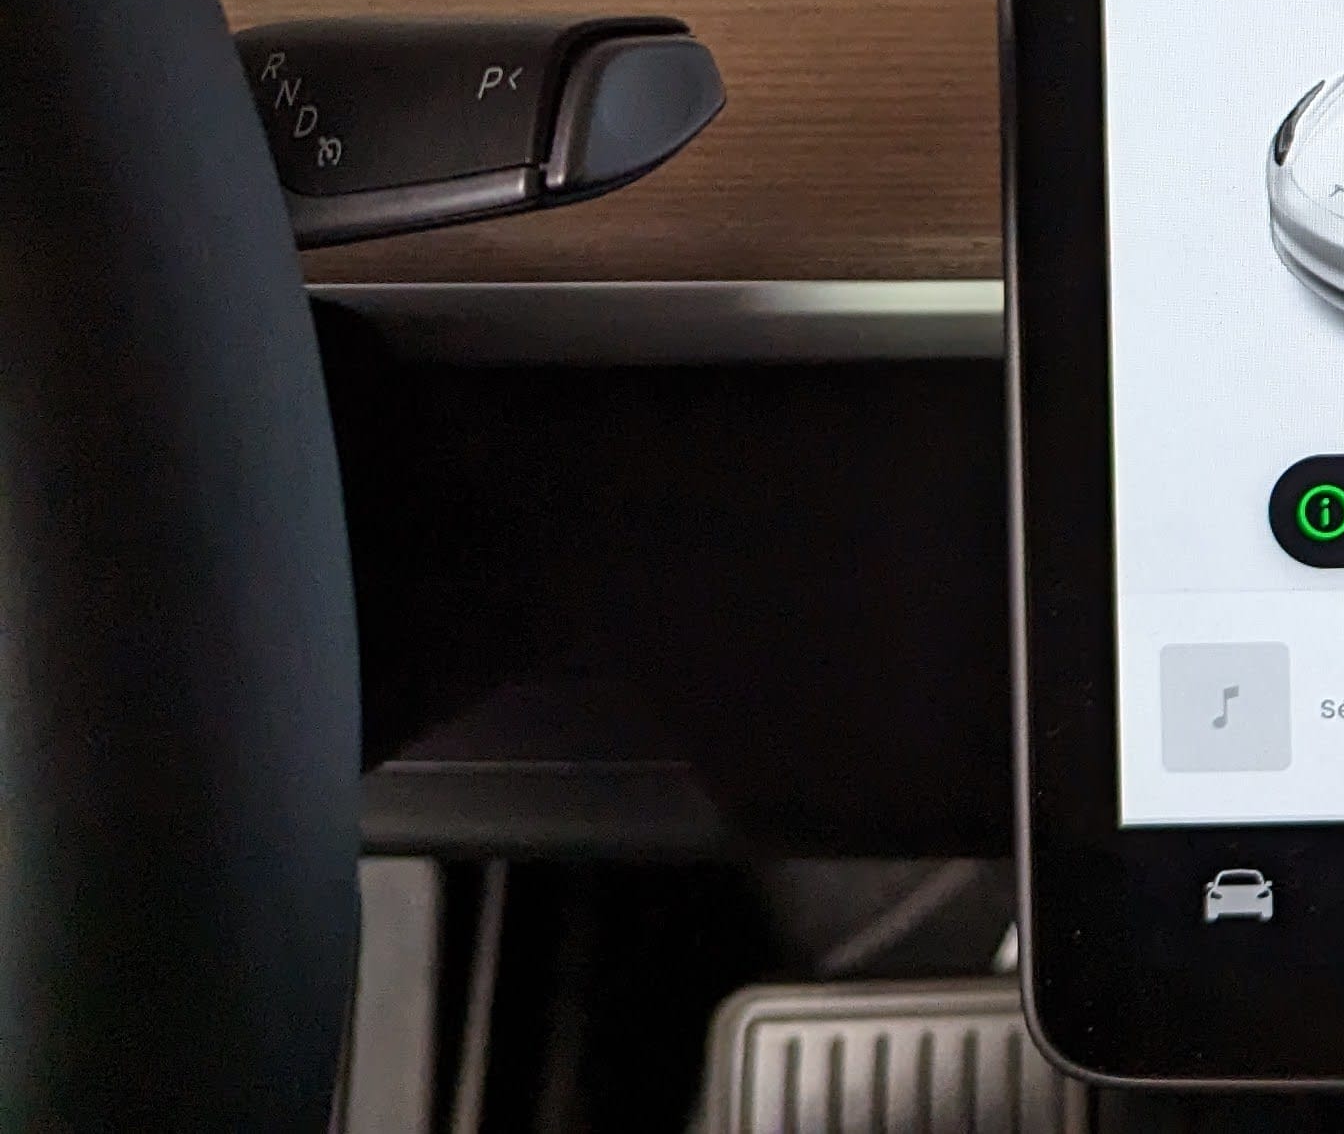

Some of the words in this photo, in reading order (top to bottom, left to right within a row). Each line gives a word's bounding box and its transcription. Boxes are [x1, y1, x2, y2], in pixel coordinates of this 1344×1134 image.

[261, 52, 286, 82] R
[274, 77, 303, 110] N
[293, 104, 319, 139] D
